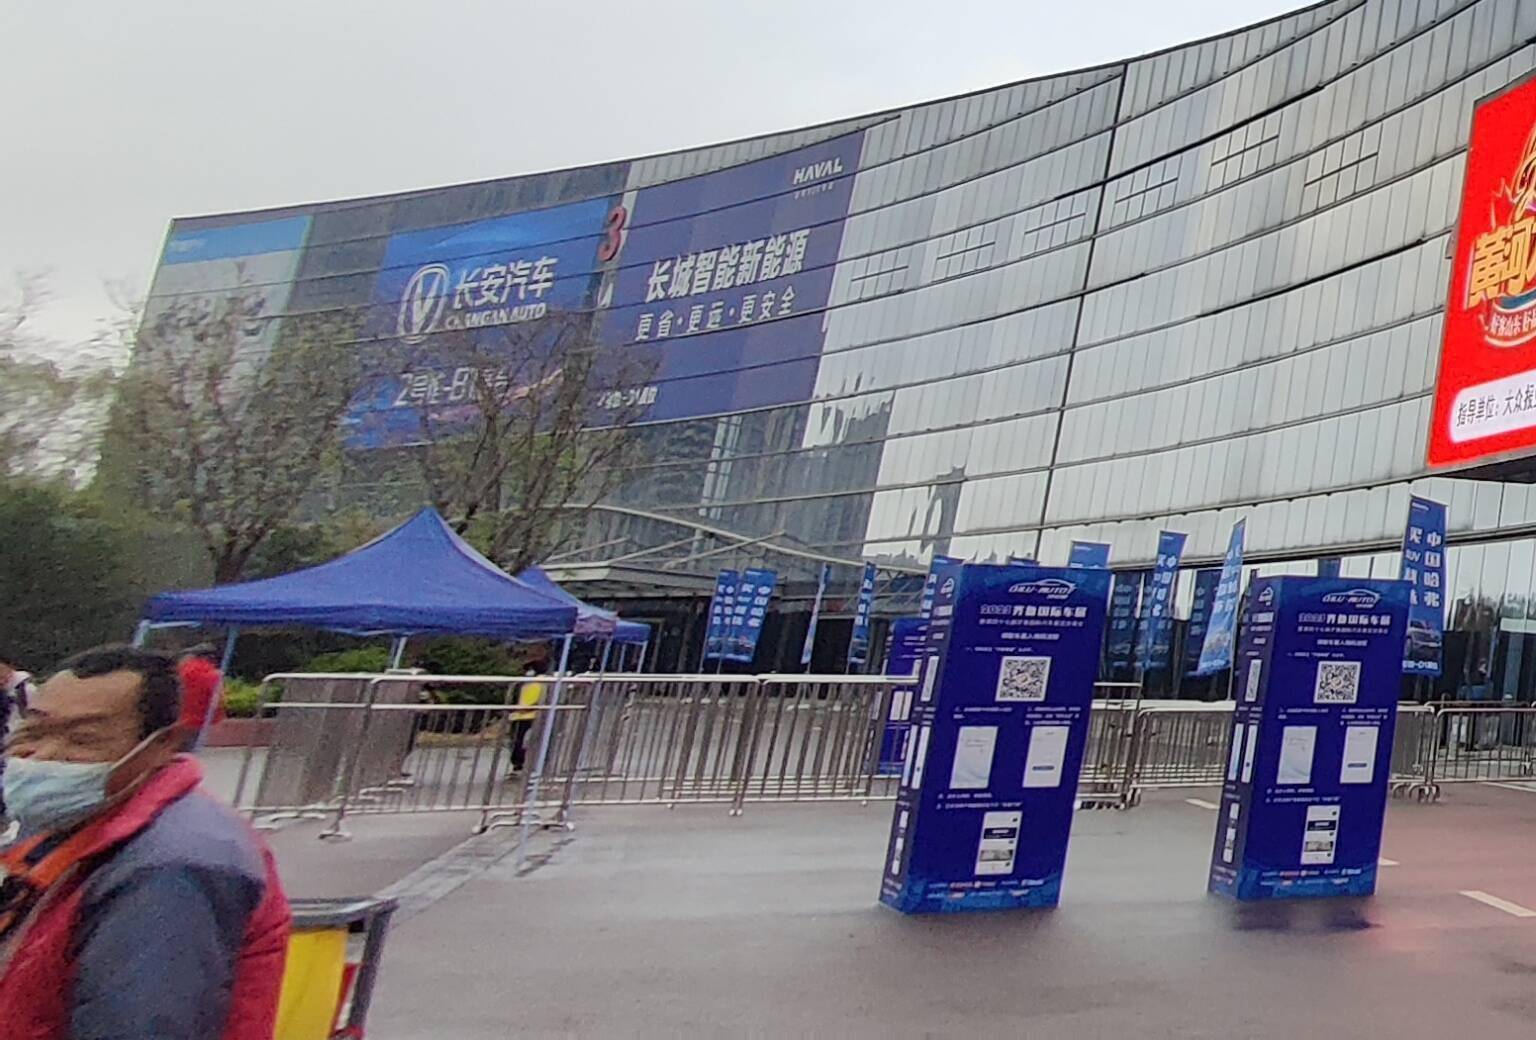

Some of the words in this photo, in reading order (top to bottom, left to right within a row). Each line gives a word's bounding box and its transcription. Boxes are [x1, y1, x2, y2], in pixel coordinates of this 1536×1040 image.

[793, 157, 843, 186] HAVAL
[453, 257, 559, 310] 长安汽车
[645, 229, 811, 303] 长城智能新能源
